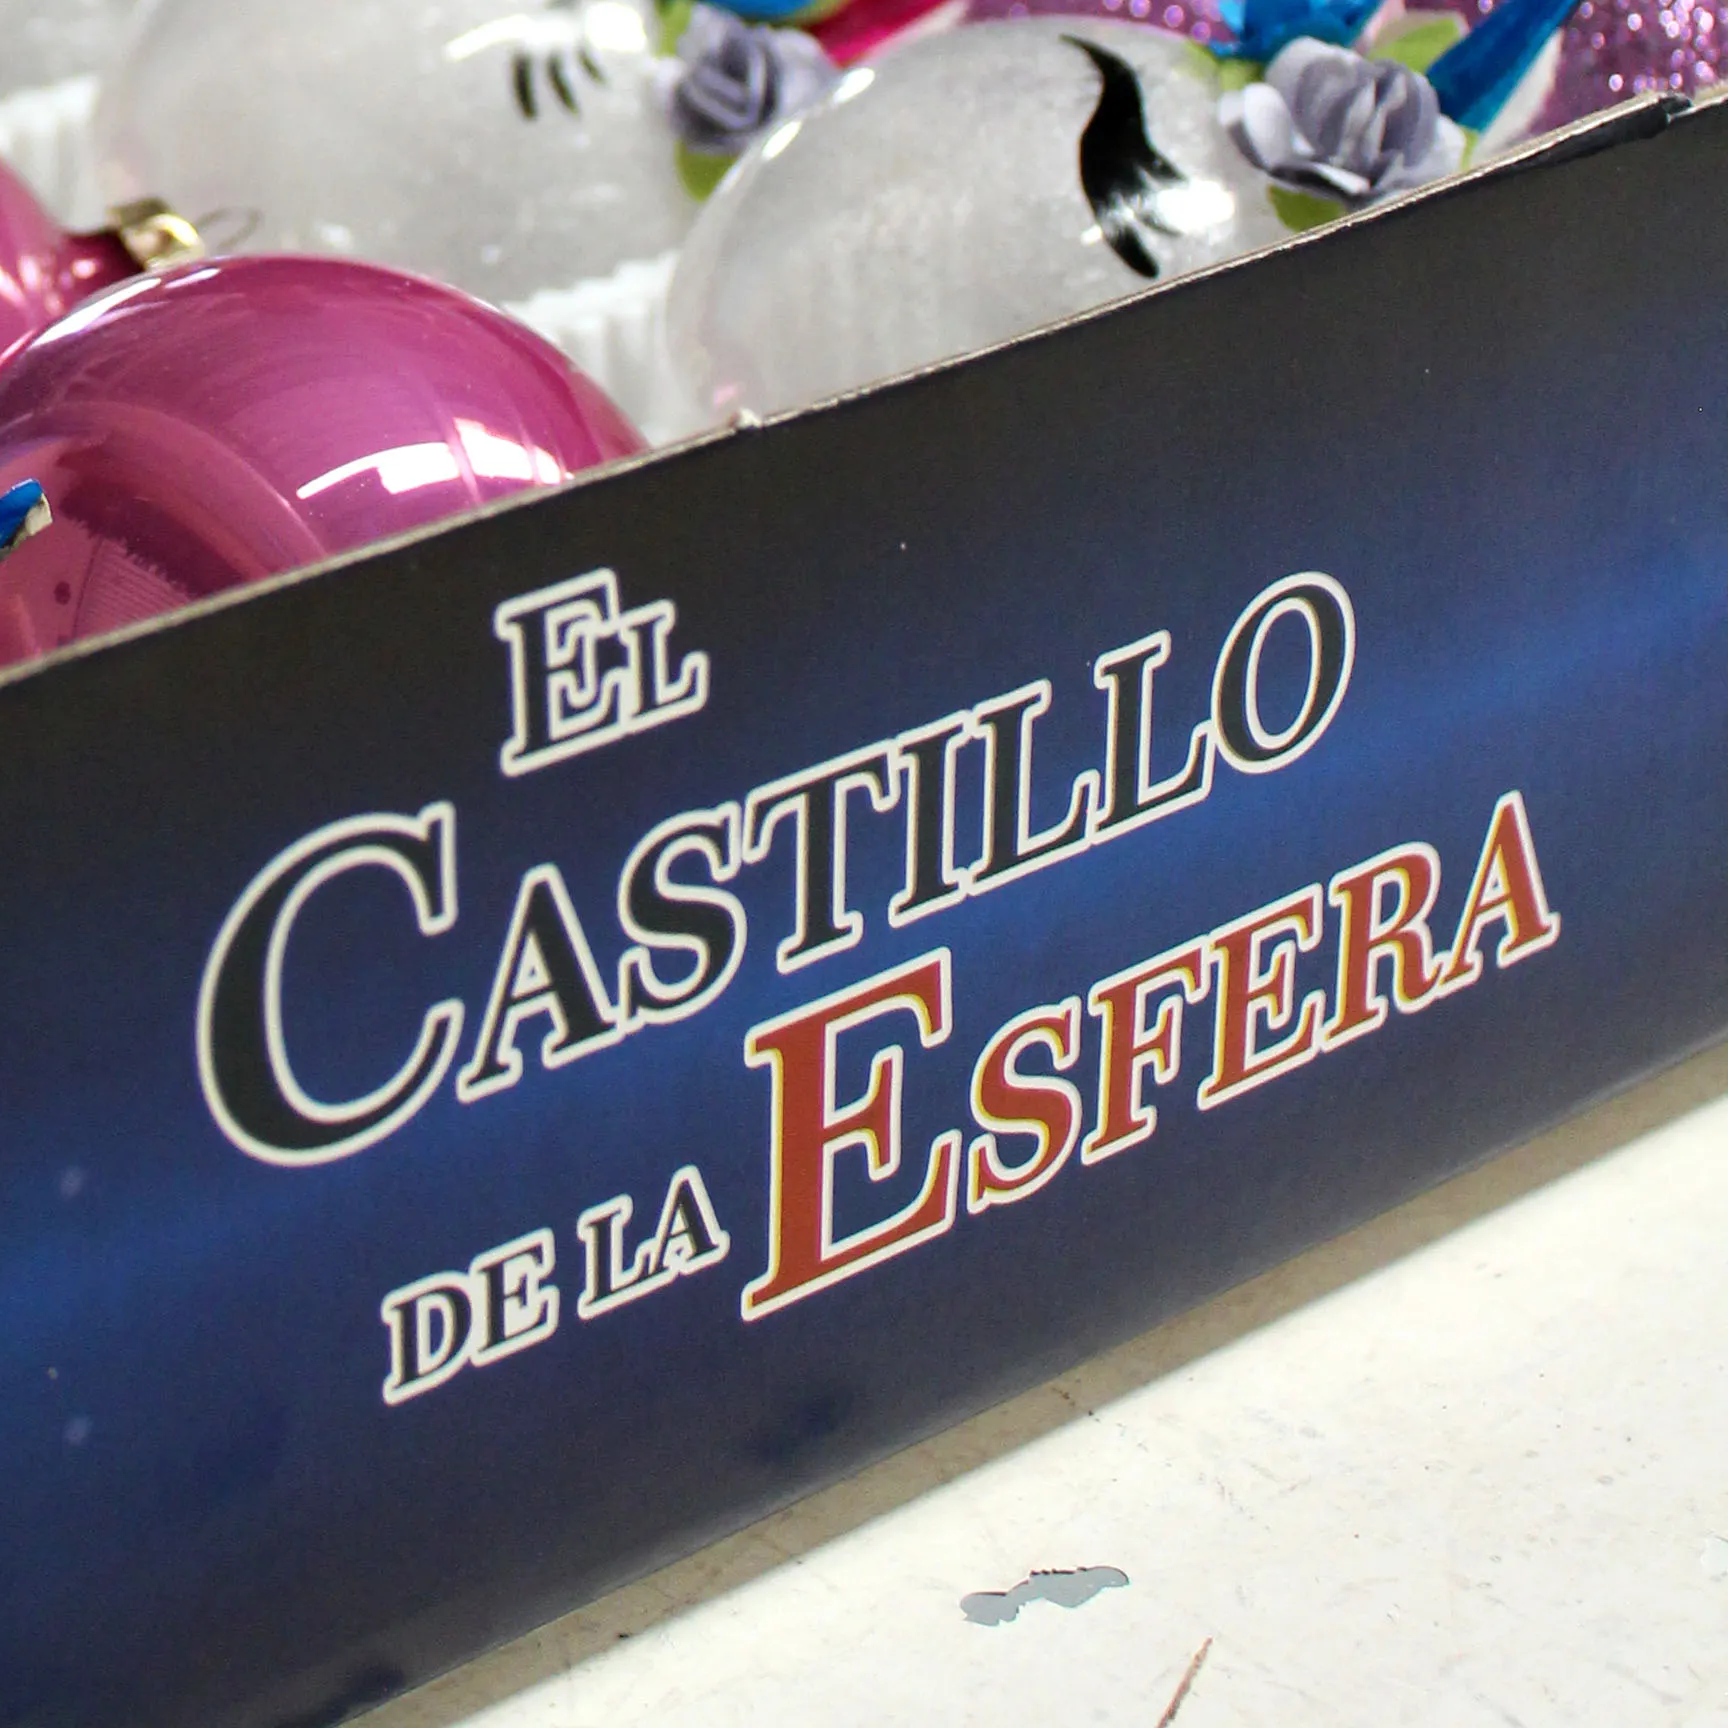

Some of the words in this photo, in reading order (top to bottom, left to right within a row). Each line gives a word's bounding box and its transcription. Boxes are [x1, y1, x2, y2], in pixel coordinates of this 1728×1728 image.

[197, 571, 1357, 1168] CASTILLO
[495, 568, 709, 777] EL
[383, 1229, 558, 1405] DE
[576, 1165, 728, 1319] LA
[742, 789, 1562, 1322] ESFERA
